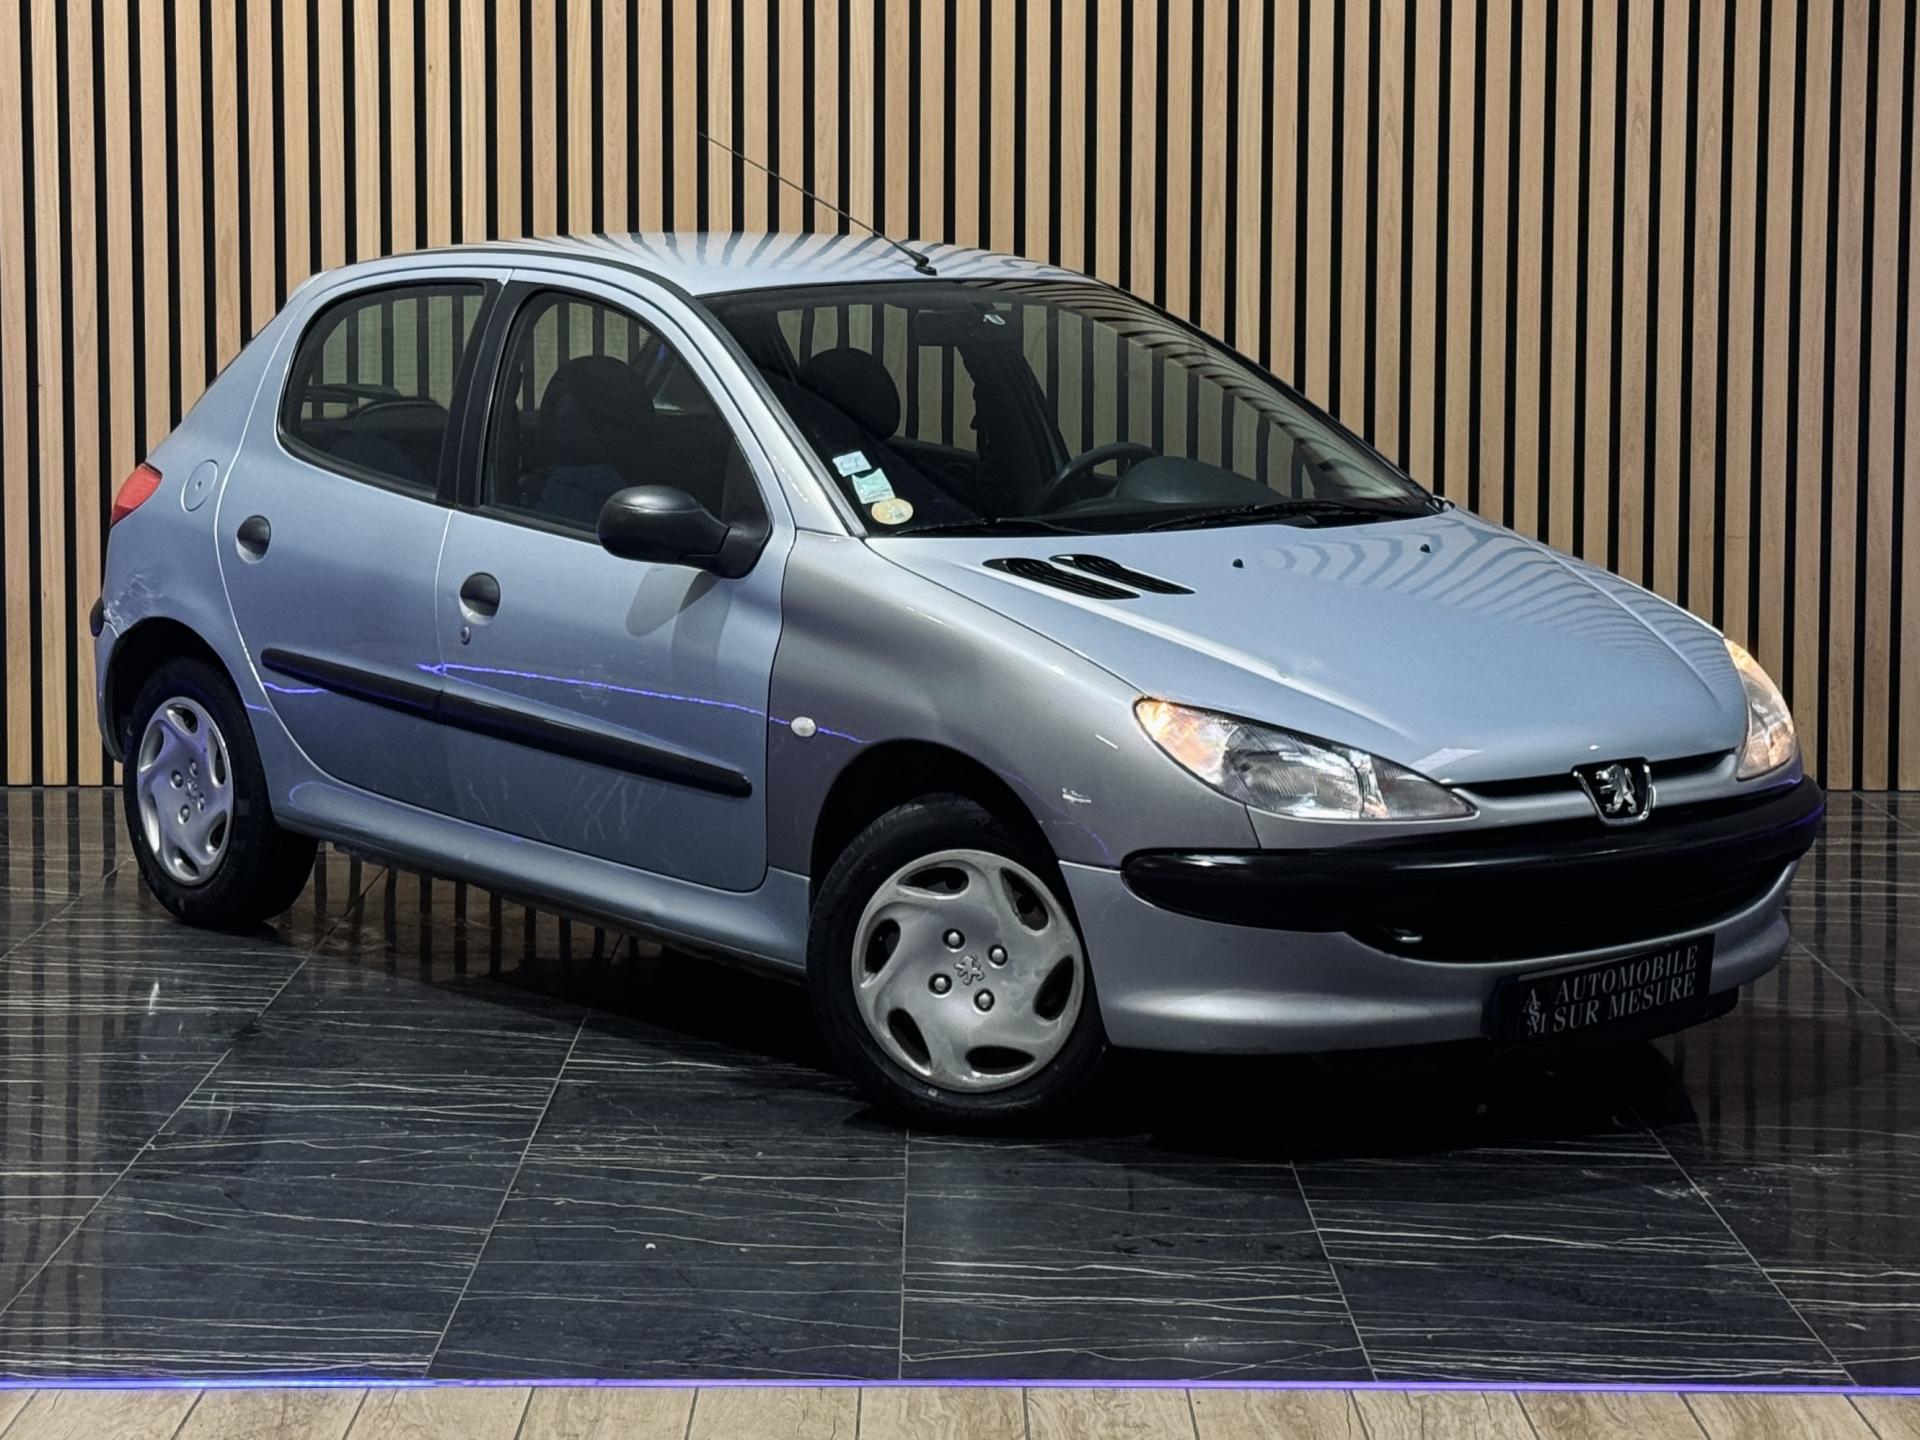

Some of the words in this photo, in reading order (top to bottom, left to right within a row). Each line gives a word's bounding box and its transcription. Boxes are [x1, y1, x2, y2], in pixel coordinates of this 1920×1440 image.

[1553, 1001, 1599, 1032] SUR
[1608, 973, 1696, 1019] MESURE
[1555, 946, 1698, 1004] AUTOMOBILE
